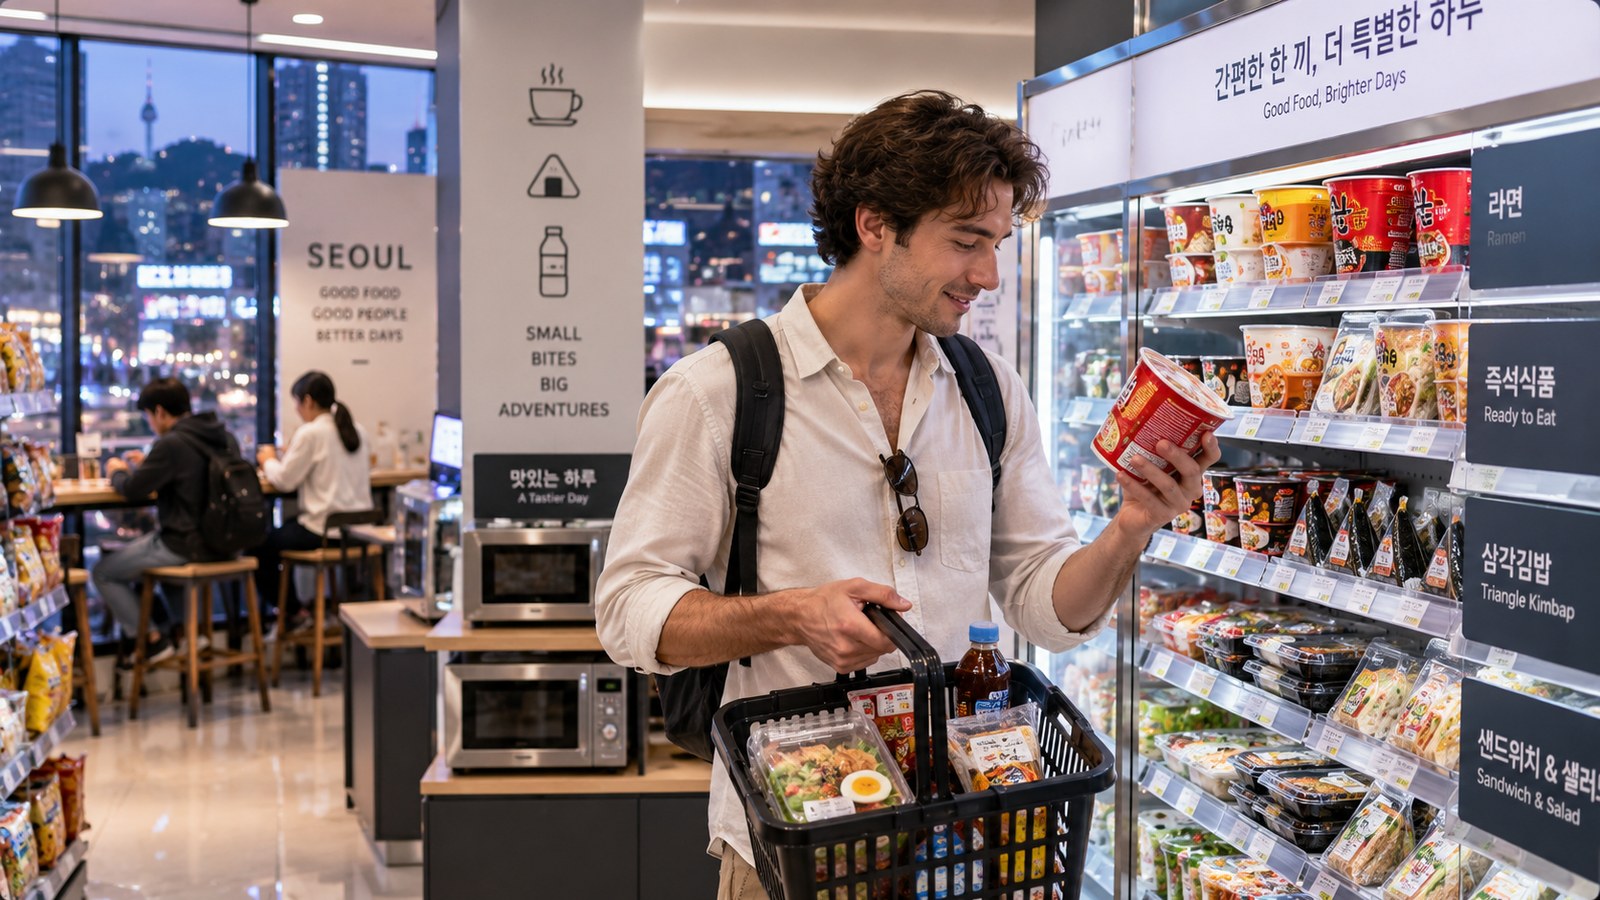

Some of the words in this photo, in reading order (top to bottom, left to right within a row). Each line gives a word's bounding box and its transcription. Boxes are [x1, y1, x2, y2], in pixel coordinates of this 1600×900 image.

[1215, 51, 1265, 102] 간편한
[1270, 44, 1288, 85] 한
[1293, 36, 1317, 77] 끼,
[1325, 25, 1342, 66] 더
[1350, 0, 1421, 60] 특별한
[1263, 97, 1290, 119] Good
[1293, 89, 1322, 109] Food,
[1325, 76, 1373, 105] Brighter
[1376, 69, 1406, 92] Days
[1488, 186, 1523, 220] 라면
[1487, 230, 1526, 247] Ramen
[307, 242, 413, 271] SEOUL
[320, 286, 360, 300] GOOD
[363, 286, 401, 300] FOOD
[312, 307, 353, 321] GOOD
[357, 307, 408, 321] PEOPLE
[317, 329, 365, 343] BETTER
[369, 329, 403, 343] DAYS
[526, 326, 582, 341] SMALL
[531, 351, 577, 366] BITES
[540, 377, 568, 392] BIG
[1485, 365, 1556, 399] 즉석식품
[499, 402, 610, 418] ADVENTURES
[1484, 406, 1518, 429] Ready
[1522, 408, 1532, 425] to
[1536, 409, 1557, 426] Eat
[510, 468, 560, 489] 맛있는
[563, 468, 597, 489] 하루
[517, 492, 527, 504] A
[529, 492, 565, 504] Tastier
[567, 492, 589, 506] Day
[1481, 543, 1552, 586] 삼각김밥
[1481, 583, 1526, 610] Triangle
[1529, 594, 1575, 623] Kimbap
[1478, 728, 1540, 780] 샌드위치
[1544, 755, 1558, 784] &
[1477, 767, 1531, 807] Sandwich
[1534, 792, 1543, 810] &
[1546, 796, 1581, 826] Salad
